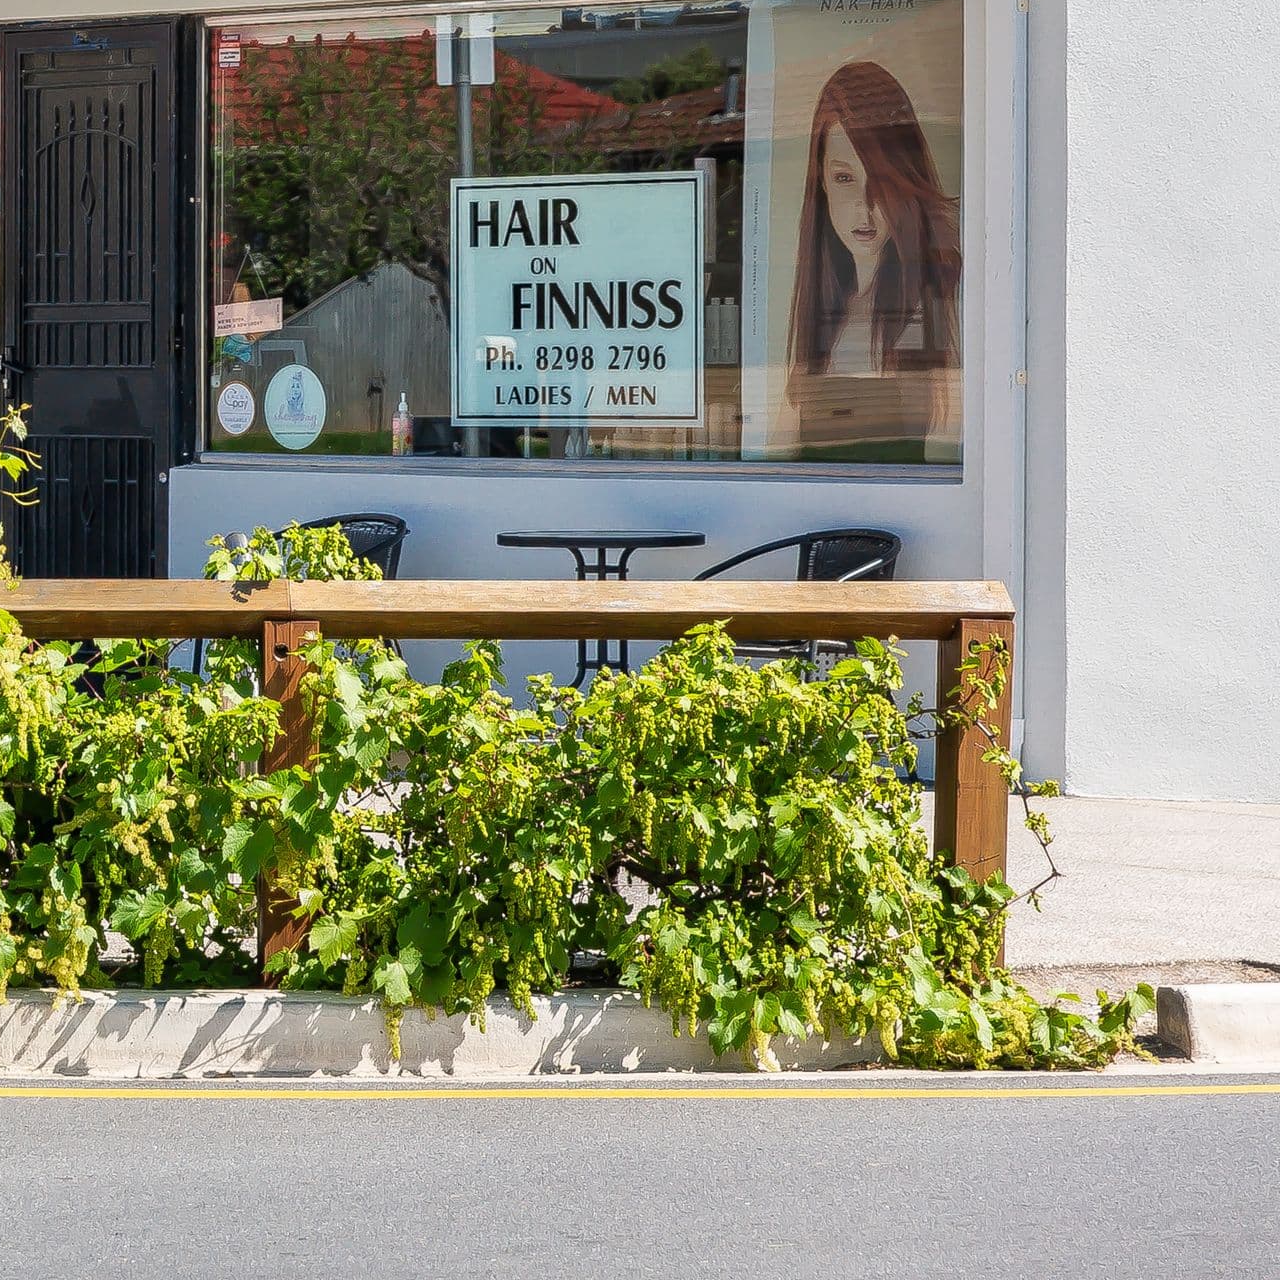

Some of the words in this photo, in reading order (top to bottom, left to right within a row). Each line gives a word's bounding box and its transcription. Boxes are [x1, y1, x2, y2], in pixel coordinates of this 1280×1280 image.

[468, 198, 580, 248] HAIR
[530, 257, 556, 276] ON
[511, 279, 684, 330] FINNISS
[485, 344, 523, 371] Ph.
[536, 344, 594, 371] 8298
[608, 344, 667, 371] 2796
[496, 386, 572, 405] LADIES
[606, 386, 657, 405] MEN
